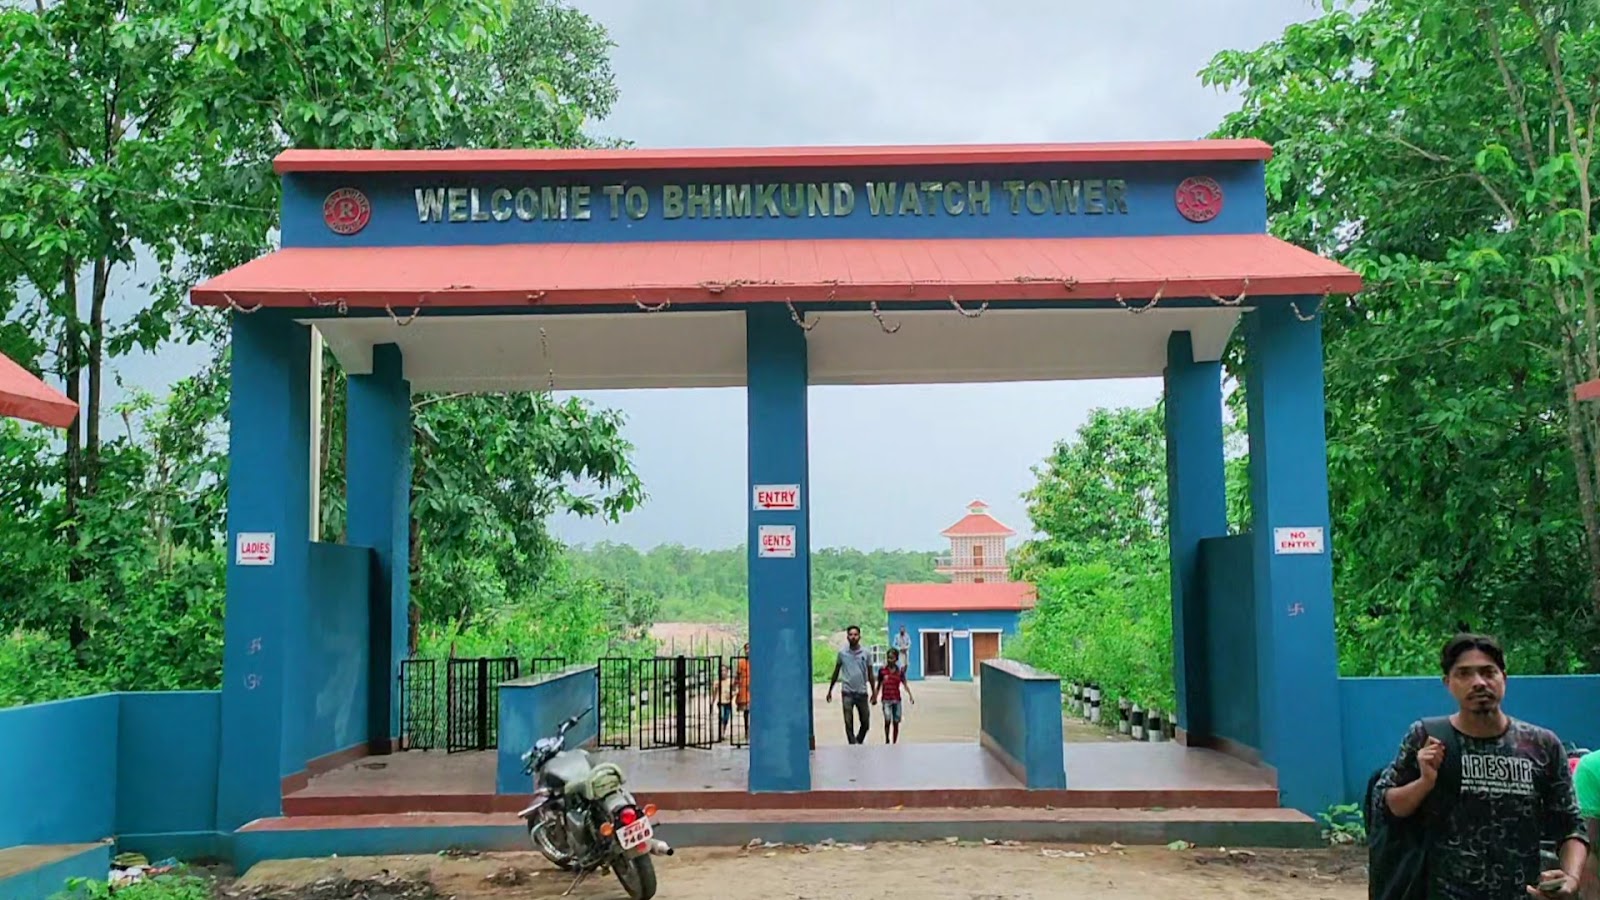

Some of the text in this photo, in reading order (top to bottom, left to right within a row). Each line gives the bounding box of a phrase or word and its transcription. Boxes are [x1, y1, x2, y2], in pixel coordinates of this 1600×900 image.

[414, 179, 1129, 222] WELCOME TO BHIMKUND WATCH TOWER
[758, 491, 795, 503] ENTRY
[762, 535, 791, 546] GENTS
[241, 542, 270, 554] LADIES
